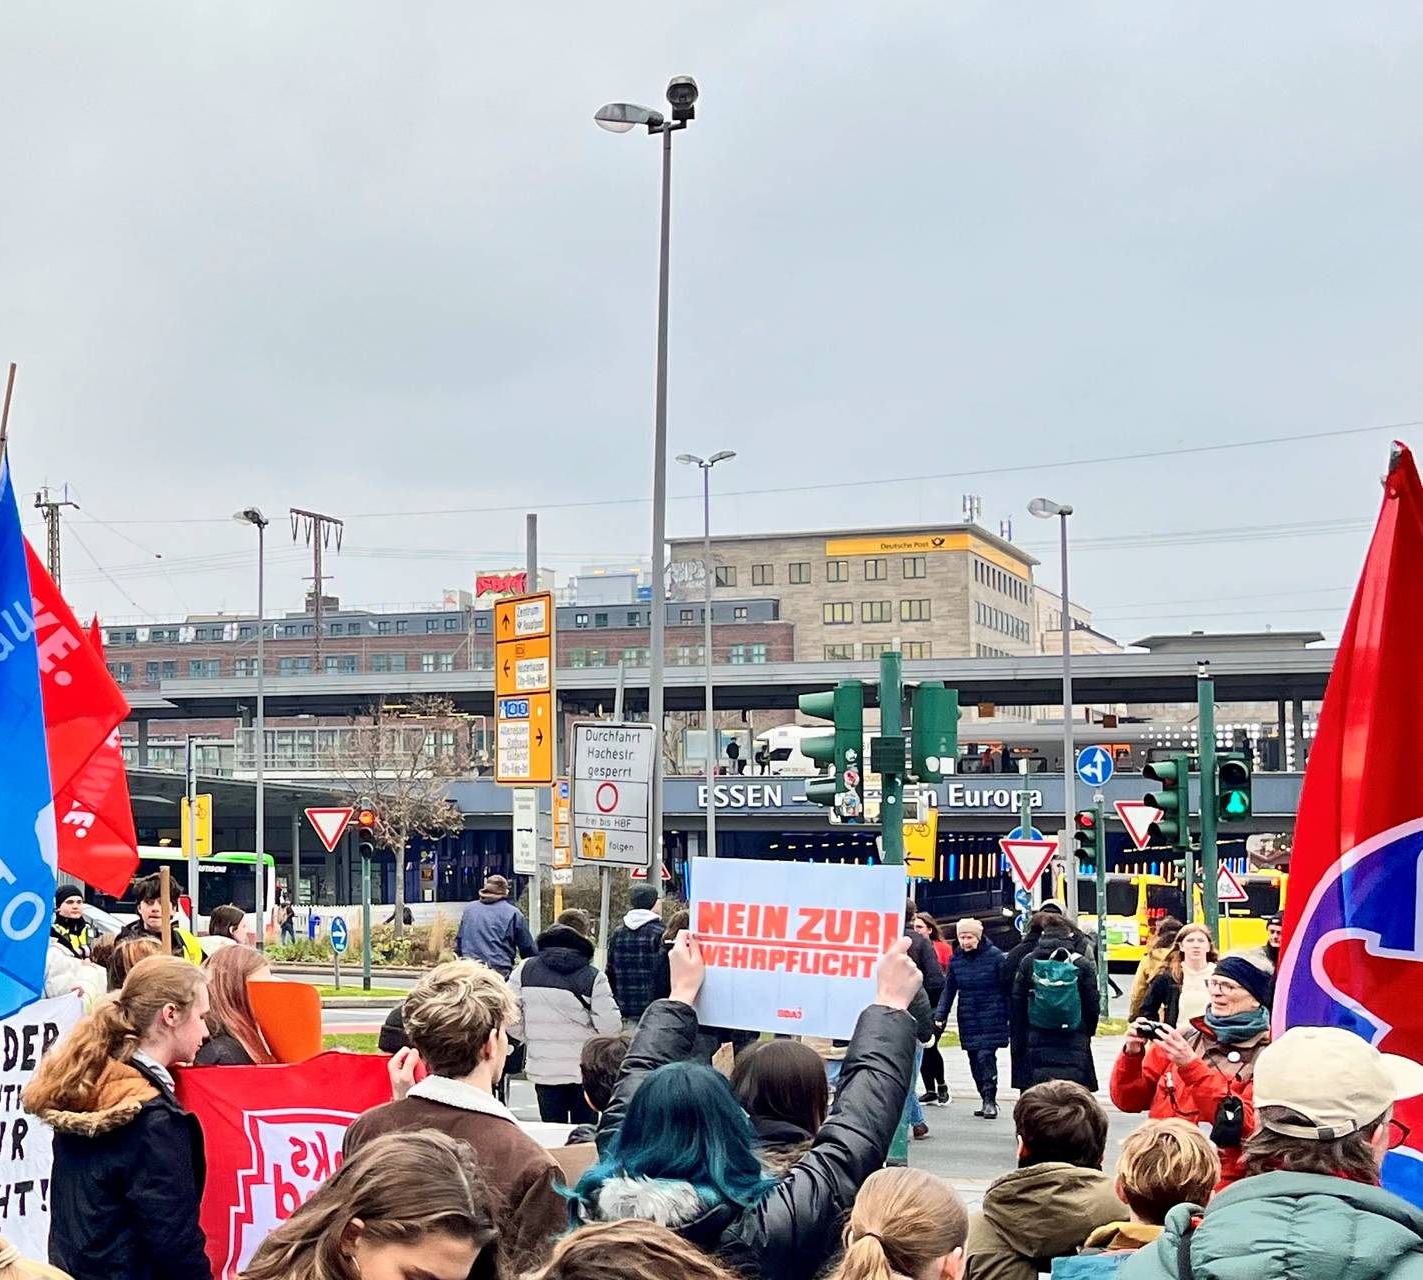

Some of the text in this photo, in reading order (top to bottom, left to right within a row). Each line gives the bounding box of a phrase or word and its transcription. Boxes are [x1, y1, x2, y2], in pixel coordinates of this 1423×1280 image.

[880, 541, 929, 550] Deutsche Post
[585, 729, 641, 744] Durchfahrt
[588, 766, 632, 779] gesperrt
[698, 784, 783, 808] ESSEN
[948, 783, 1043, 812] Europa
[609, 841, 634, 853] folgen
[697, 901, 790, 939] NEIN
[700, 944, 877, 978] WEHRPFLICHT
